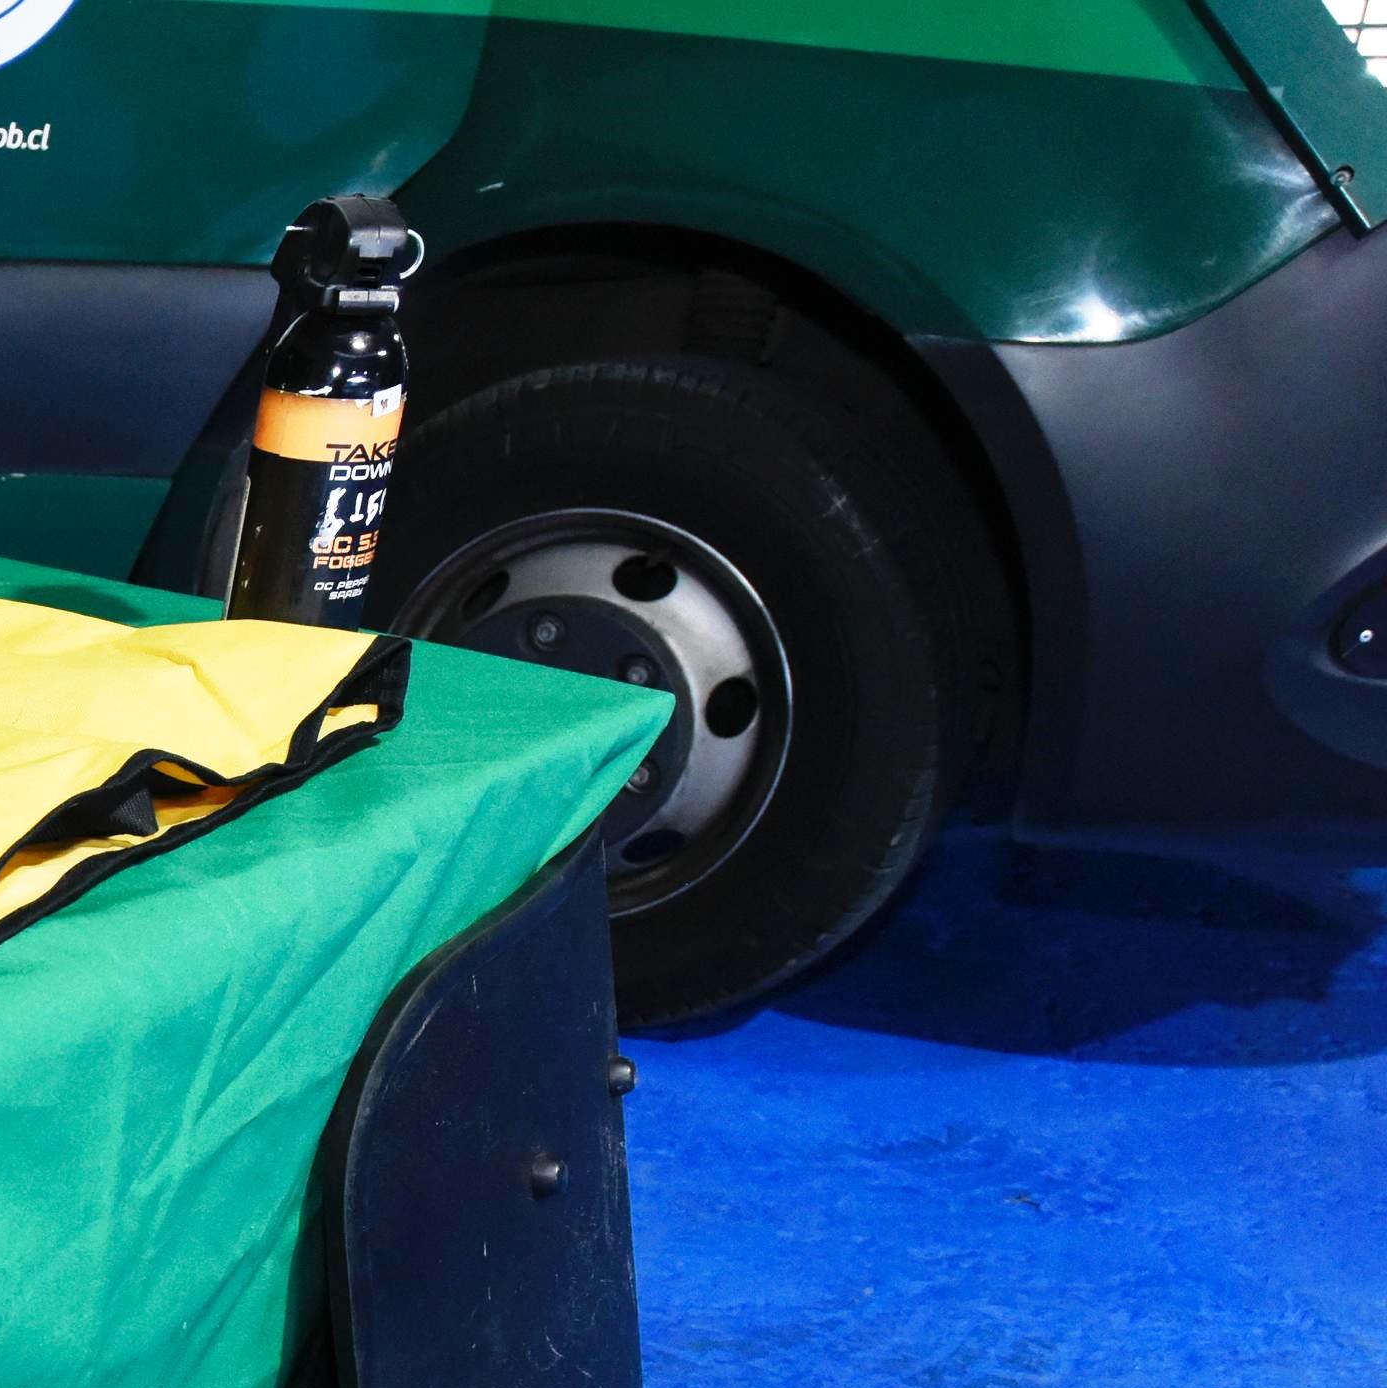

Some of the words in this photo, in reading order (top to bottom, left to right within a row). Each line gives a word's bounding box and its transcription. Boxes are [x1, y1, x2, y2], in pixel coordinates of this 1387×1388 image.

[326, 438, 398, 464] TAKE
[329, 458, 394, 481] DOWN
[313, 550, 376, 569] FOGGE
[314, 582, 334, 591] OC
